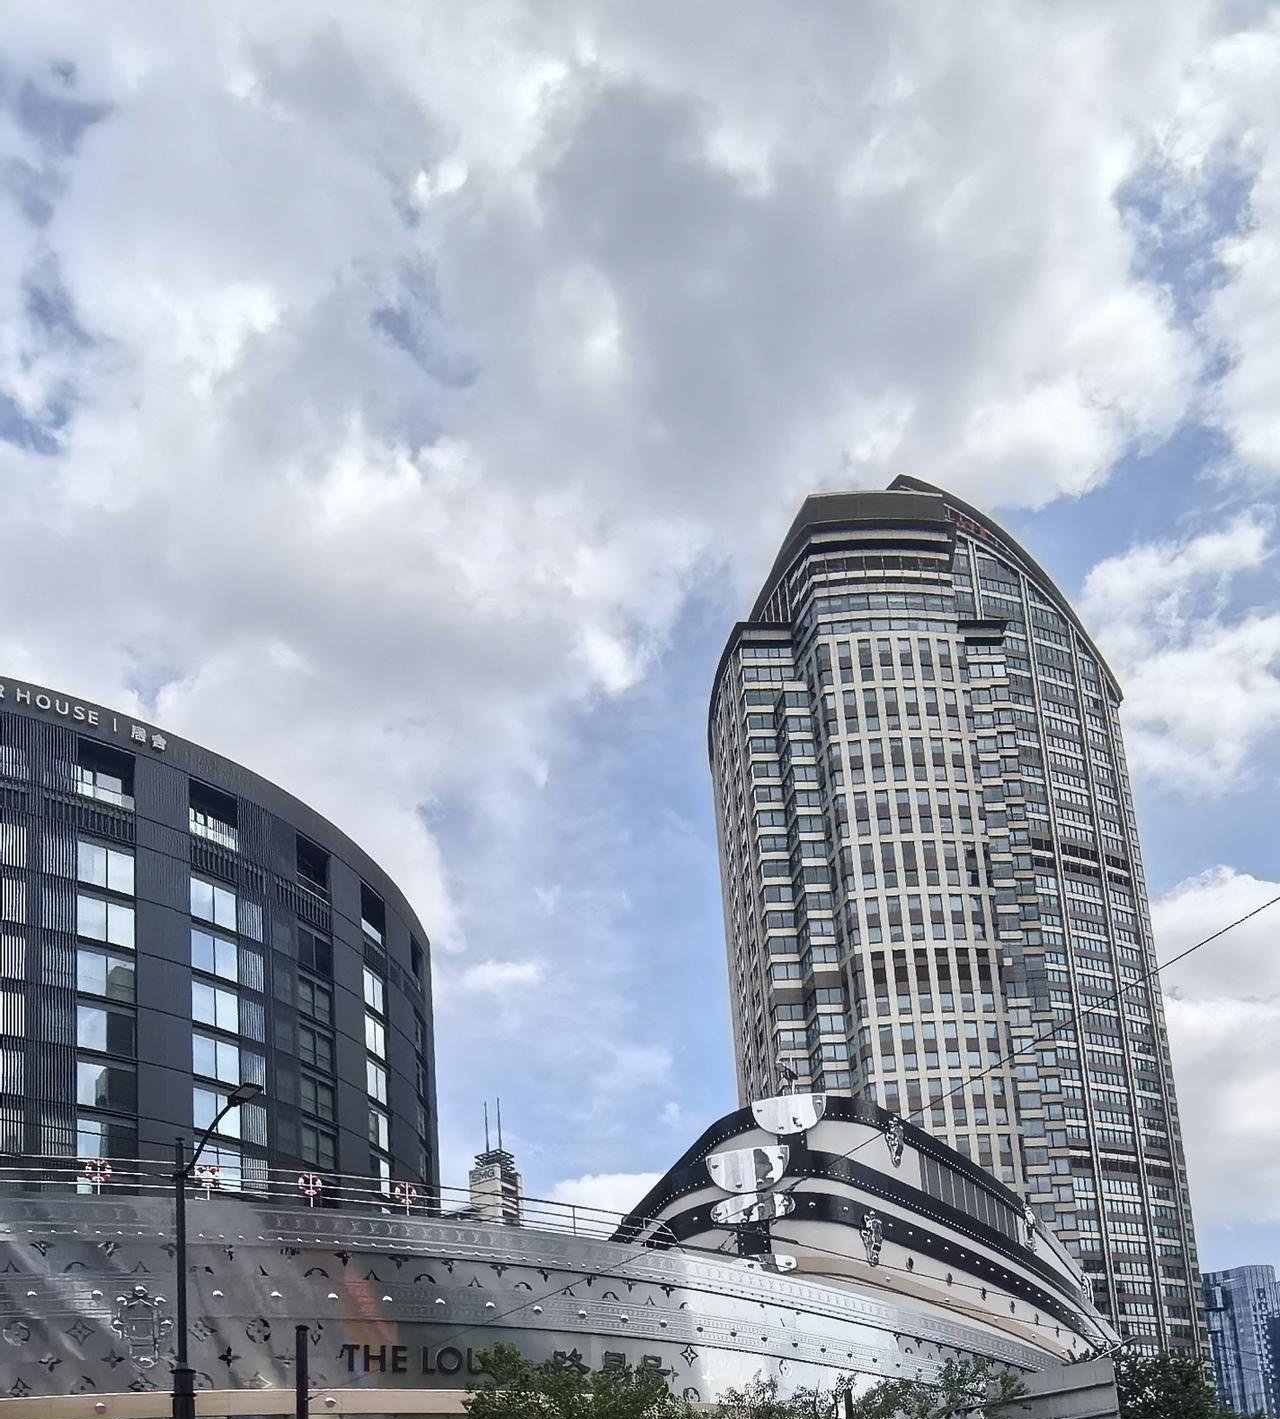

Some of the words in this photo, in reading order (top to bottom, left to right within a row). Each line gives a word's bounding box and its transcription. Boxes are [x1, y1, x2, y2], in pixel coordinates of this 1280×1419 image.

[16, 687, 99, 725] HOUSE
[471, 1168, 495, 1182] SMG
[342, 1344, 408, 1373] THE
[421, 1345, 493, 1376] LOU
